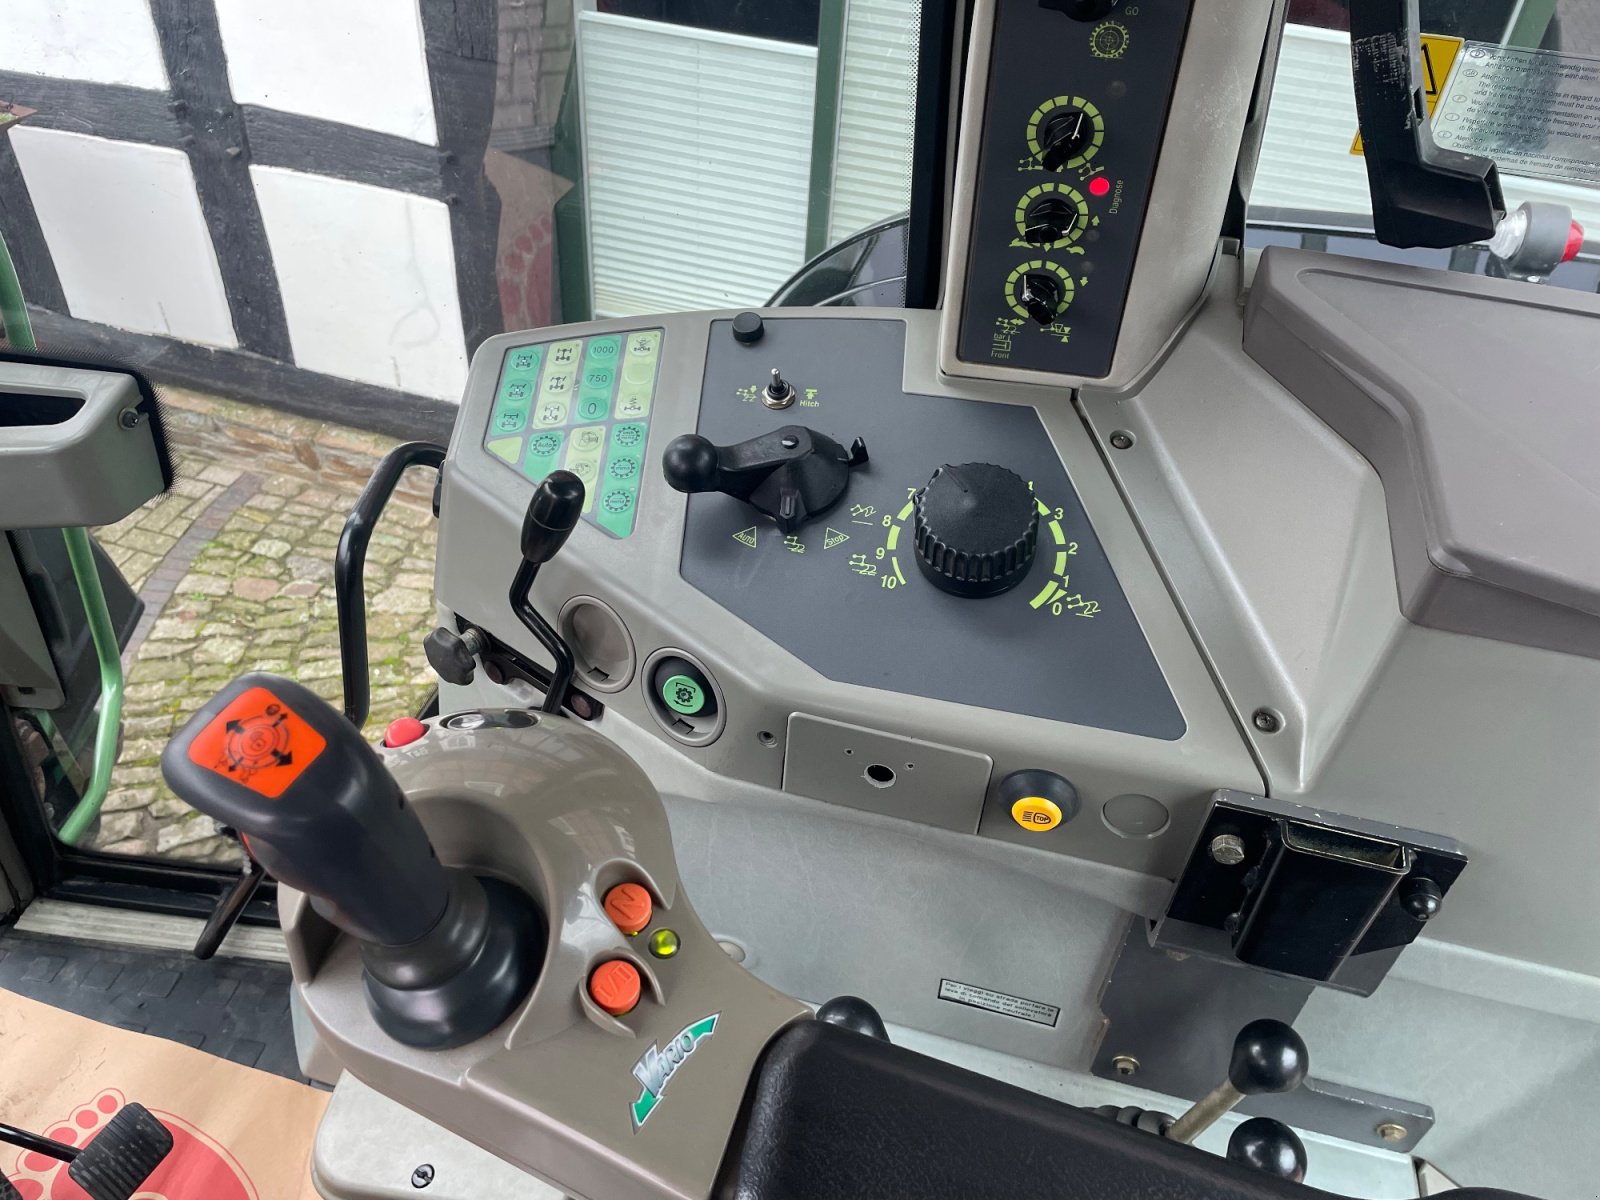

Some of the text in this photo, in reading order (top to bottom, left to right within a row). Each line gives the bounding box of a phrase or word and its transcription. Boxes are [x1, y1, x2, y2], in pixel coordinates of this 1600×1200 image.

[1109, 180, 1123, 214] Diagnose
[592, 346, 614, 354] 1000
[991, 350, 1010, 359] Front
[589, 374, 608, 383] 750
[588, 402, 597, 415] 0
[907, 487, 917, 499] 7
[1054, 507, 1064, 520] 3
[882, 515, 892, 527] 8
[738, 532, 755, 544] AUTO
[826, 534, 844, 545] Stop
[875, 547, 885, 560] 9
[1068, 542, 1078, 555] 2
[881, 574, 897, 589] 10
[1063, 575, 1069, 588] 1
[1052, 602, 1062, 616] 0
